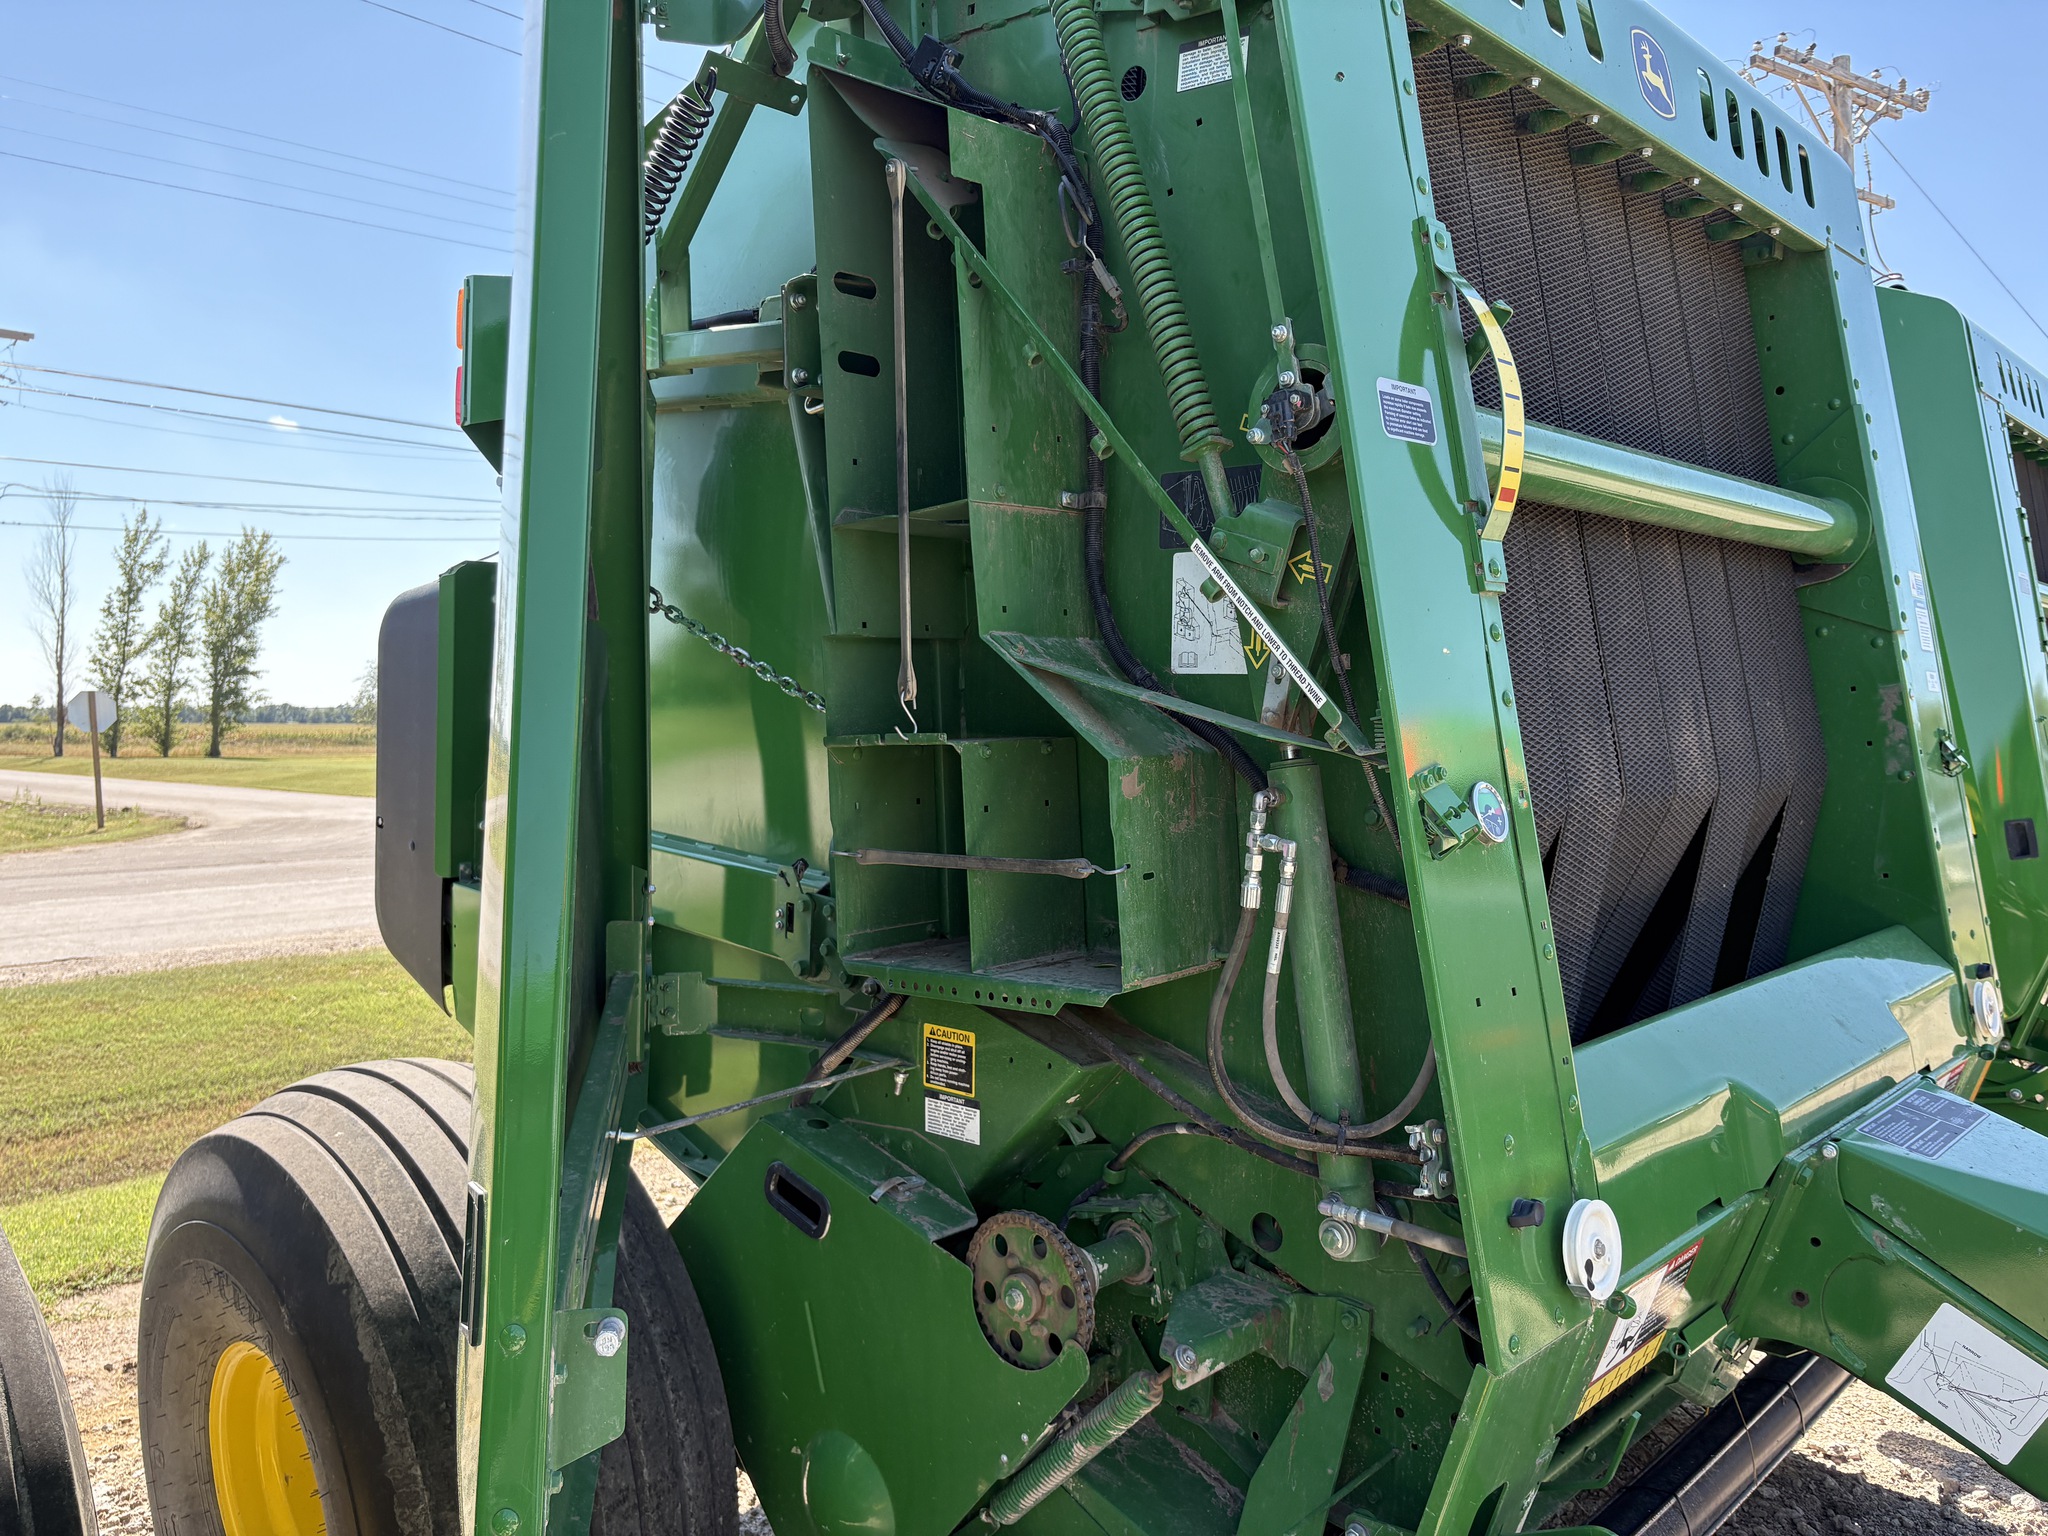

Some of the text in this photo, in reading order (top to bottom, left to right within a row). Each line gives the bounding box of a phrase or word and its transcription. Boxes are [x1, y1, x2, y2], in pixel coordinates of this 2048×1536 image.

[1198, 35, 1227, 47] IMPORTAN
[1193, 543, 1213, 569] REMOVE
[1211, 566, 1224, 583] ARM
[1222, 579, 1238, 601] FROM
[1235, 595, 1253, 619] NOTCH
[1251, 616, 1264, 631] AND
[1261, 628, 1281, 653] LOWER
[1279, 649, 1288, 662] TO
[936, 1028, 971, 1043] CAUTION
[939, 1093, 965, 1105] IMPORTANT
